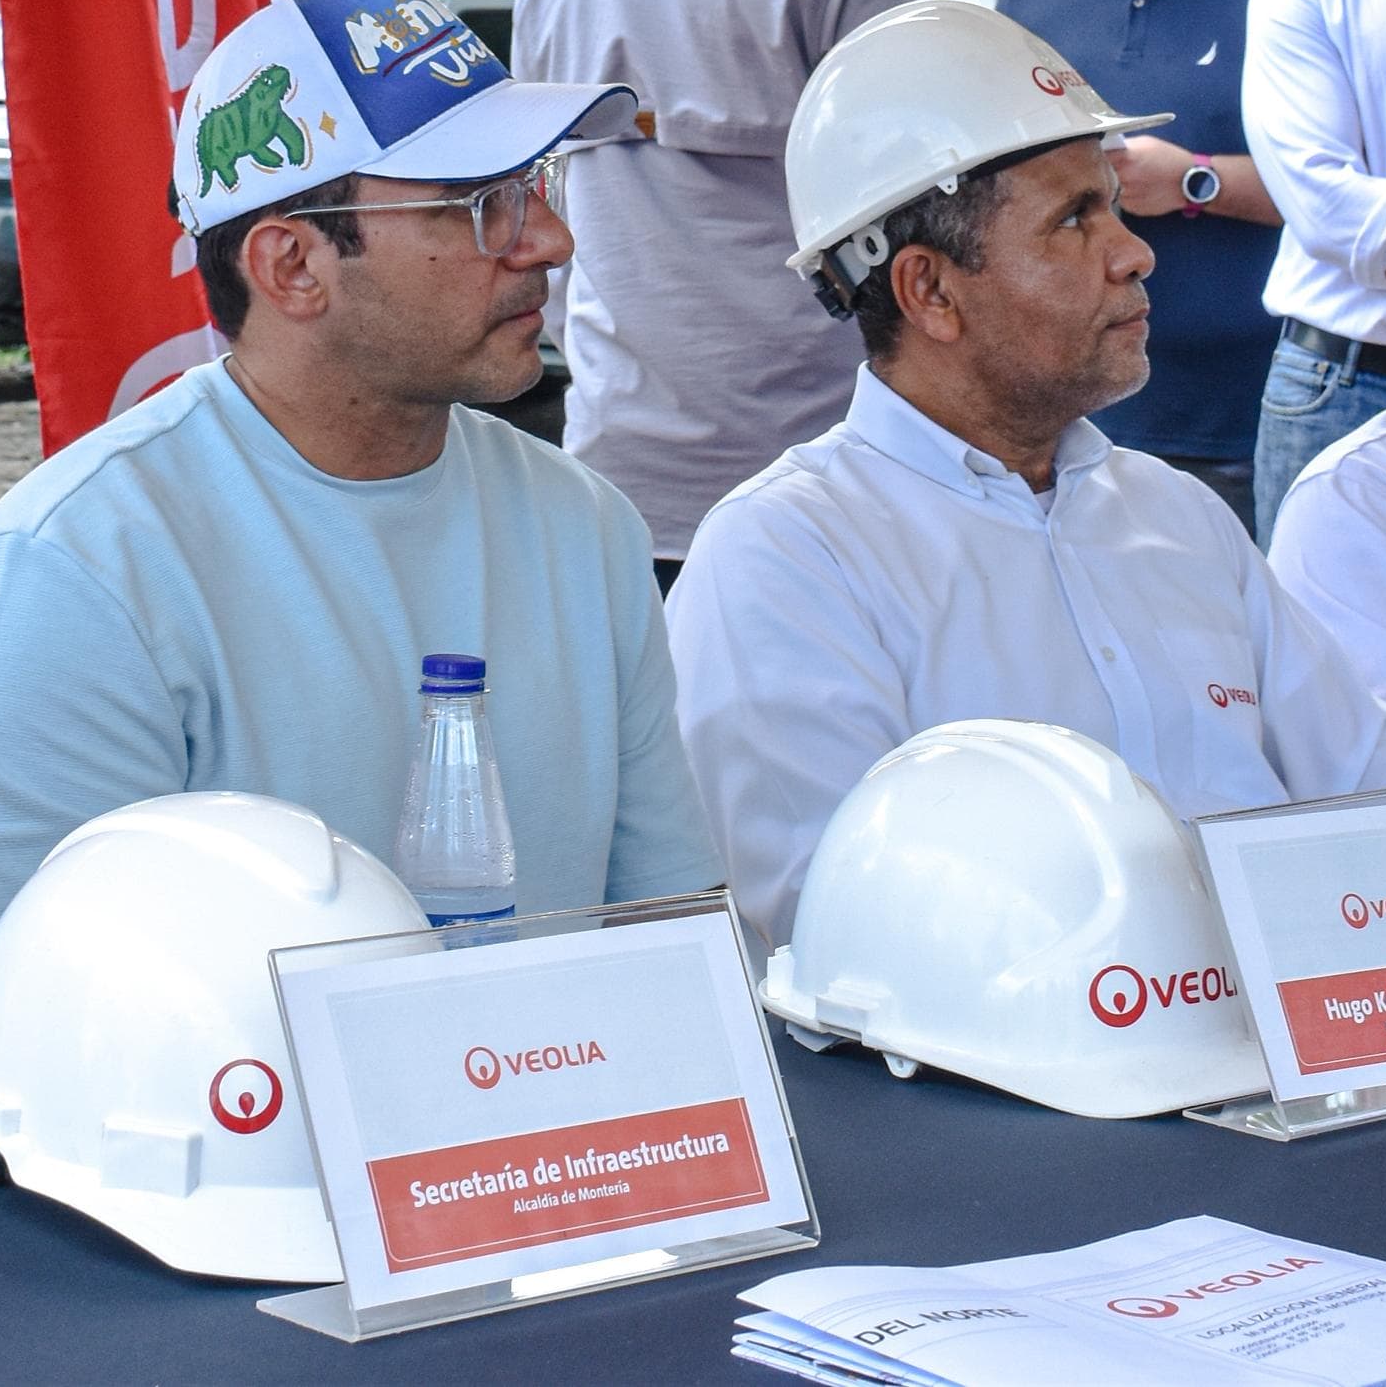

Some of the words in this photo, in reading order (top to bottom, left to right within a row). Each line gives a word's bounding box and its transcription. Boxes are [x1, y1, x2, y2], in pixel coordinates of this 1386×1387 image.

[1150, 966, 1238, 1009] VEOL
[1324, 997, 1373, 1024] Hugo
[503, 1040, 607, 1076] VEOLIA
[409, 1162, 530, 1208] Secretaría
[532, 1157, 562, 1186] de
[564, 1132, 730, 1180] Infraestructura
[513, 1190, 560, 1214] Alcaldía
[560, 1189, 577, 1205] de
[577, 1179, 631, 1202] Montería
[1166, 1256, 1324, 1301] VEOLIA
[853, 1318, 927, 1347] DEL
[918, 1307, 1029, 1326] NORTE
